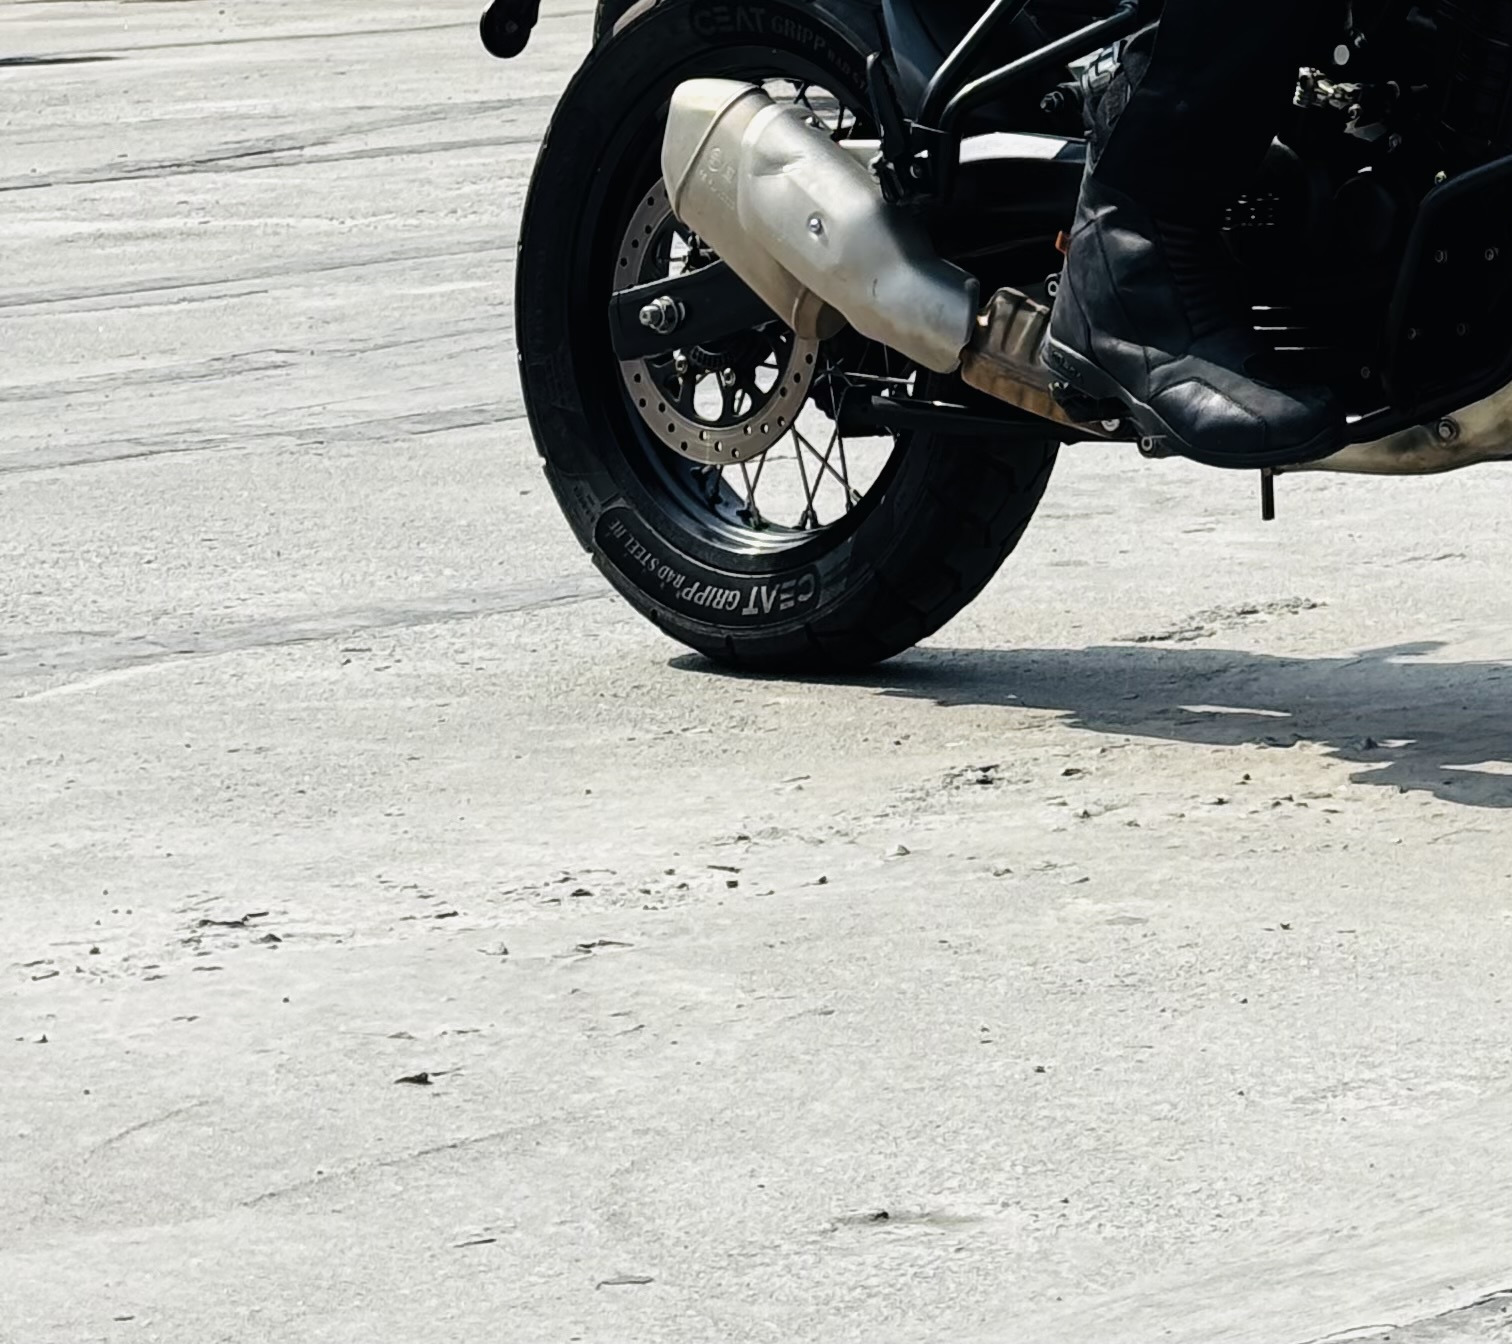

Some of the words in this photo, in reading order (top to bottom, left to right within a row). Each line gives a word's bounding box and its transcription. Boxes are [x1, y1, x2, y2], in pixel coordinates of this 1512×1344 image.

[624, 534, 659, 571] STEEL
[657, 565, 686, 588] RAD
[681, 582, 740, 611] GRIPP
[742, 573, 815, 616] CEAT
